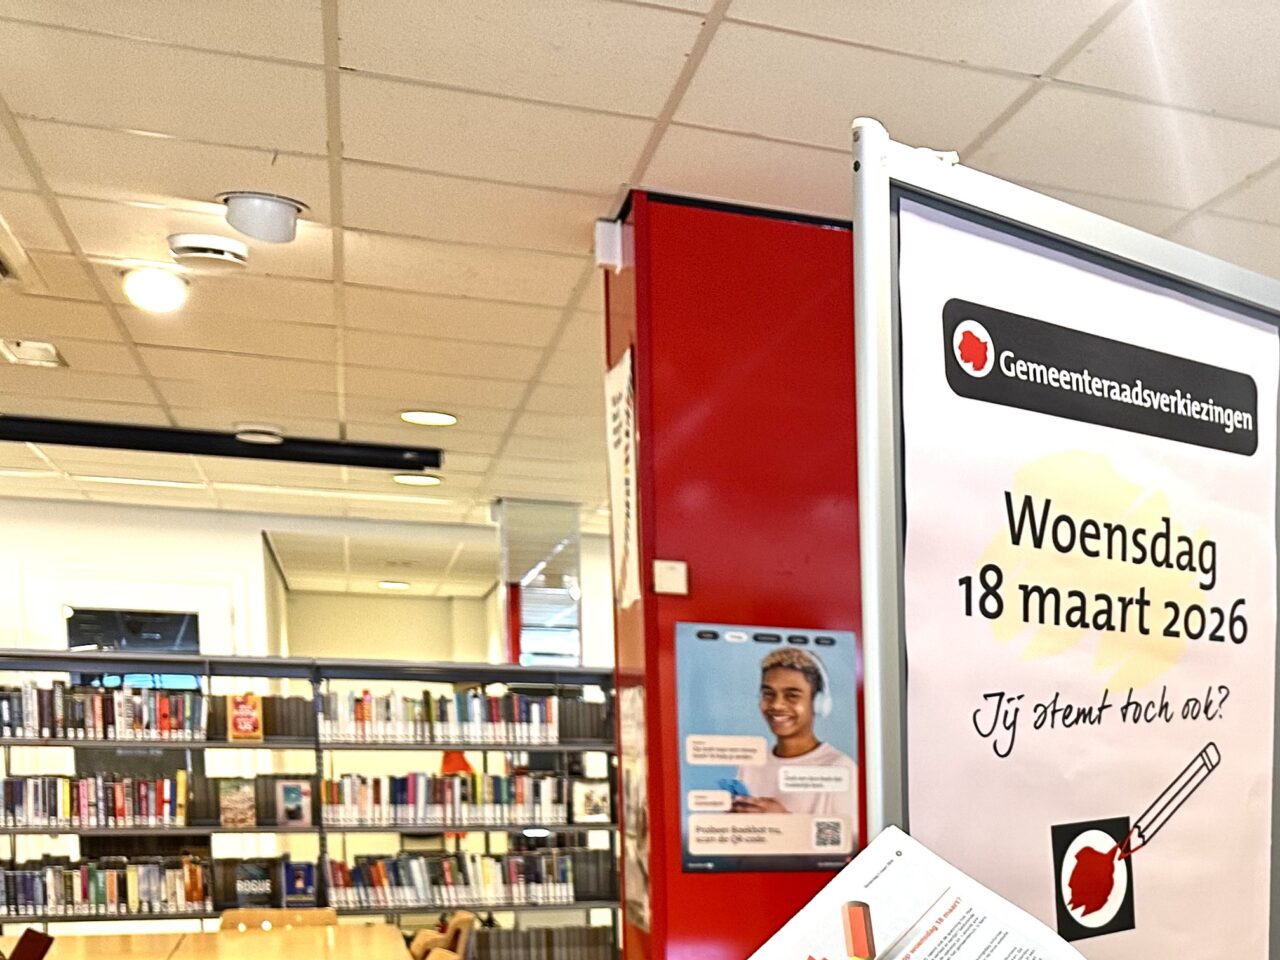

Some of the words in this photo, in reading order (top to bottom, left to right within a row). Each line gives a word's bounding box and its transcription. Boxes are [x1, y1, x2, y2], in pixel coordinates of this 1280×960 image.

[1000, 350, 1253, 434] Gemeenteraadsverkiezingen
[1004, 490, 1217, 591] Woensdag
[957, 564, 1004, 619] 18
[1018, 580, 1150, 636] maart
[1162, 598, 1248, 644] 2026
[972, 692, 1025, 758] Jij
[1033, 688, 1112, 730] stemt
[1120, 686, 1174, 725] toch
[1181, 686, 1230, 722] ook?
